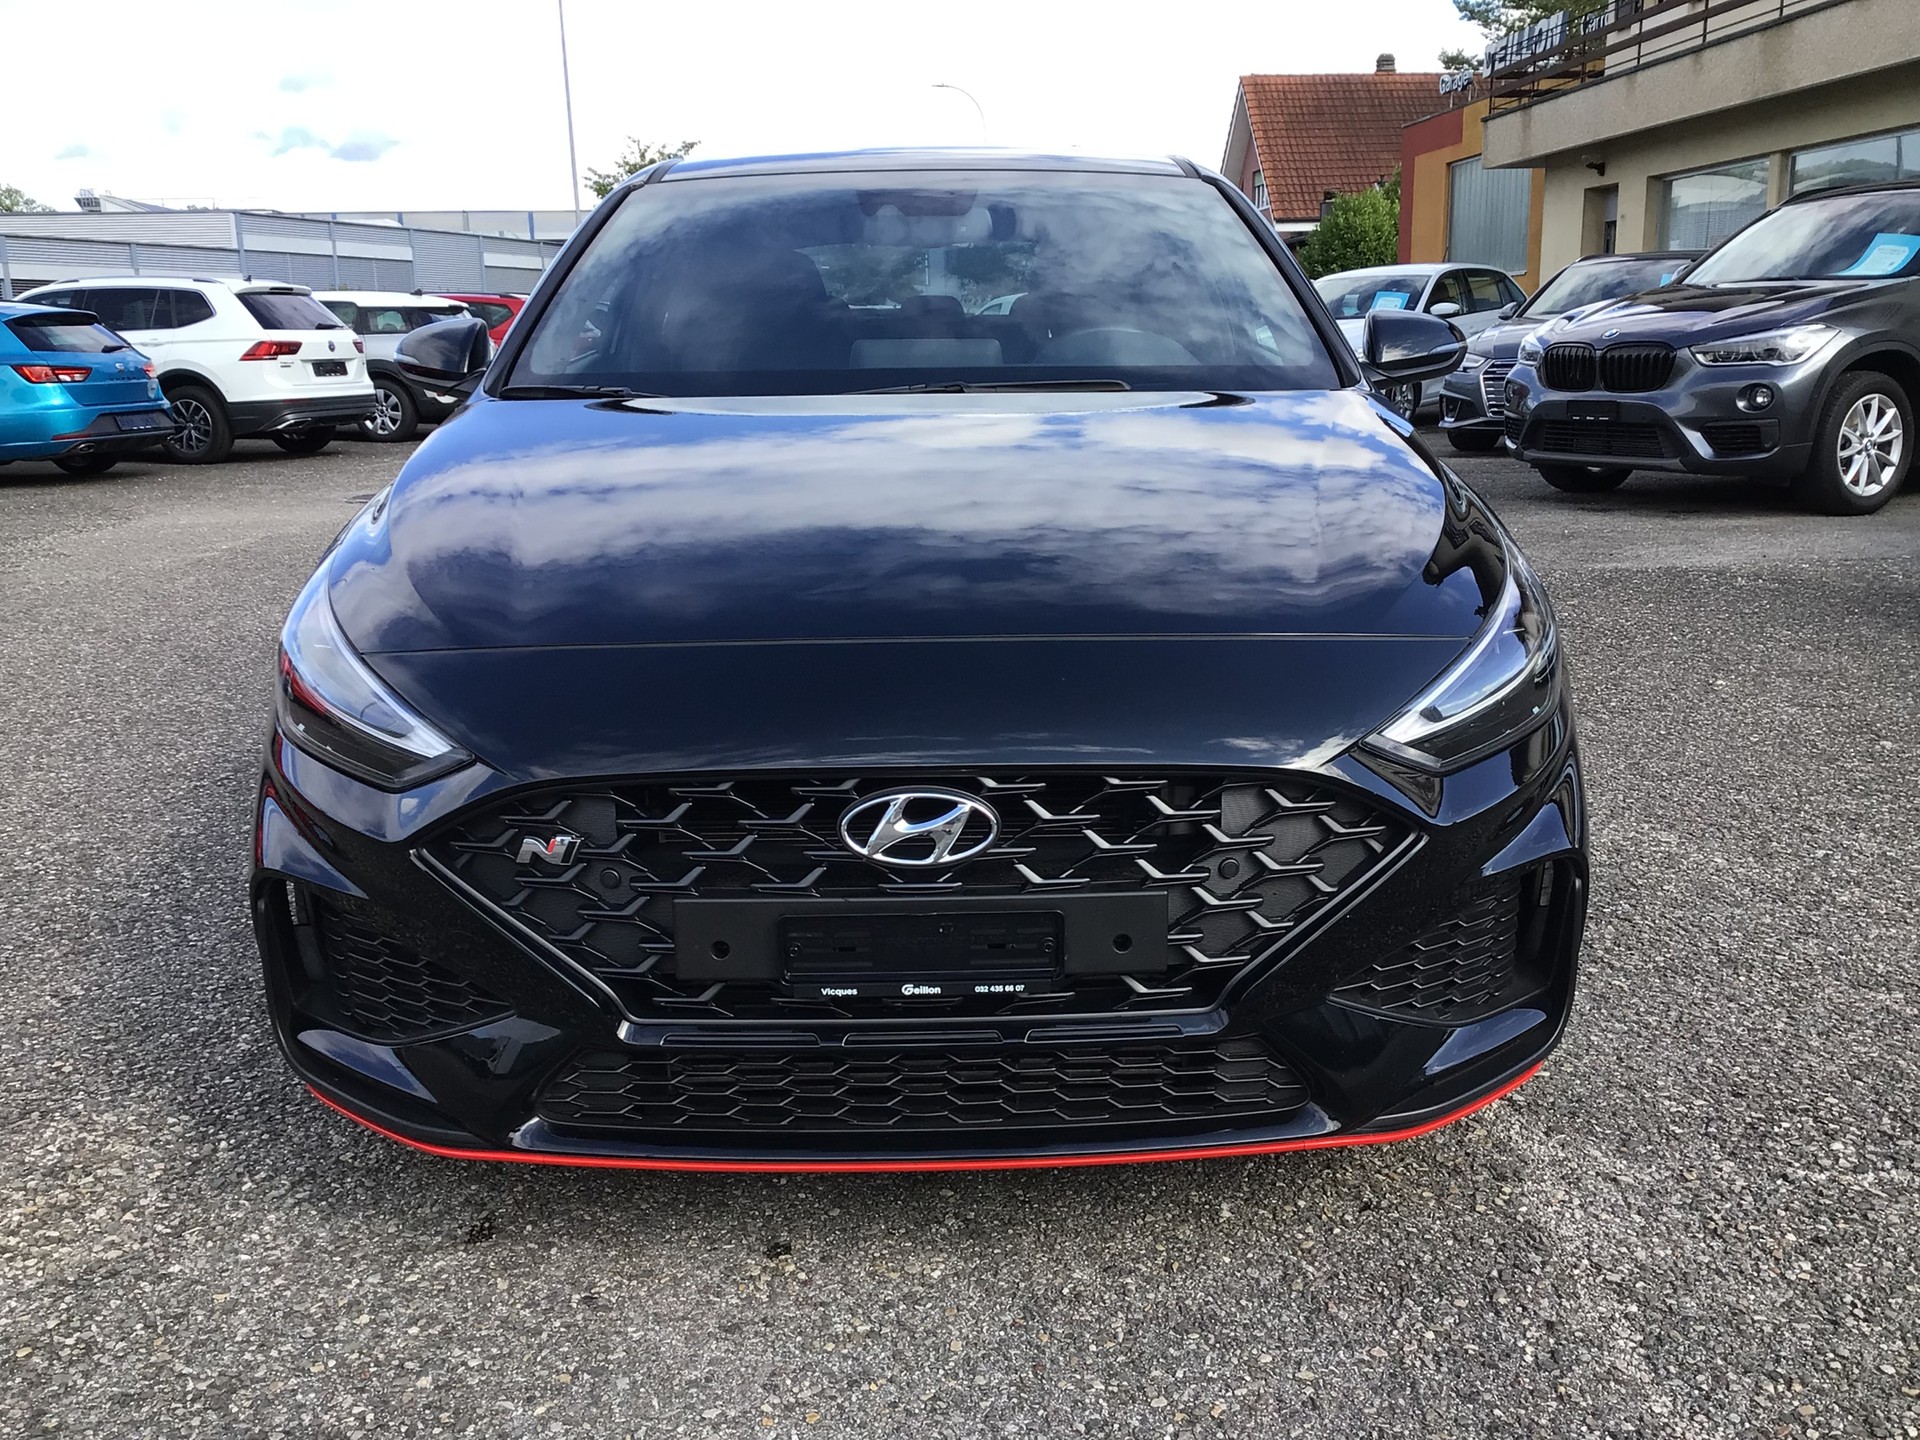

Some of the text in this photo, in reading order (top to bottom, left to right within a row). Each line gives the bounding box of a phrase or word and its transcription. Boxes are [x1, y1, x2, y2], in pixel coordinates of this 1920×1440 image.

[1440, 70, 1472, 94] Garage
[821, 988, 858, 997] Vicques
[901, 984, 941, 995] Geillon
[974, 985, 988, 993] 032
[1015, 984, 1025, 992] 07
